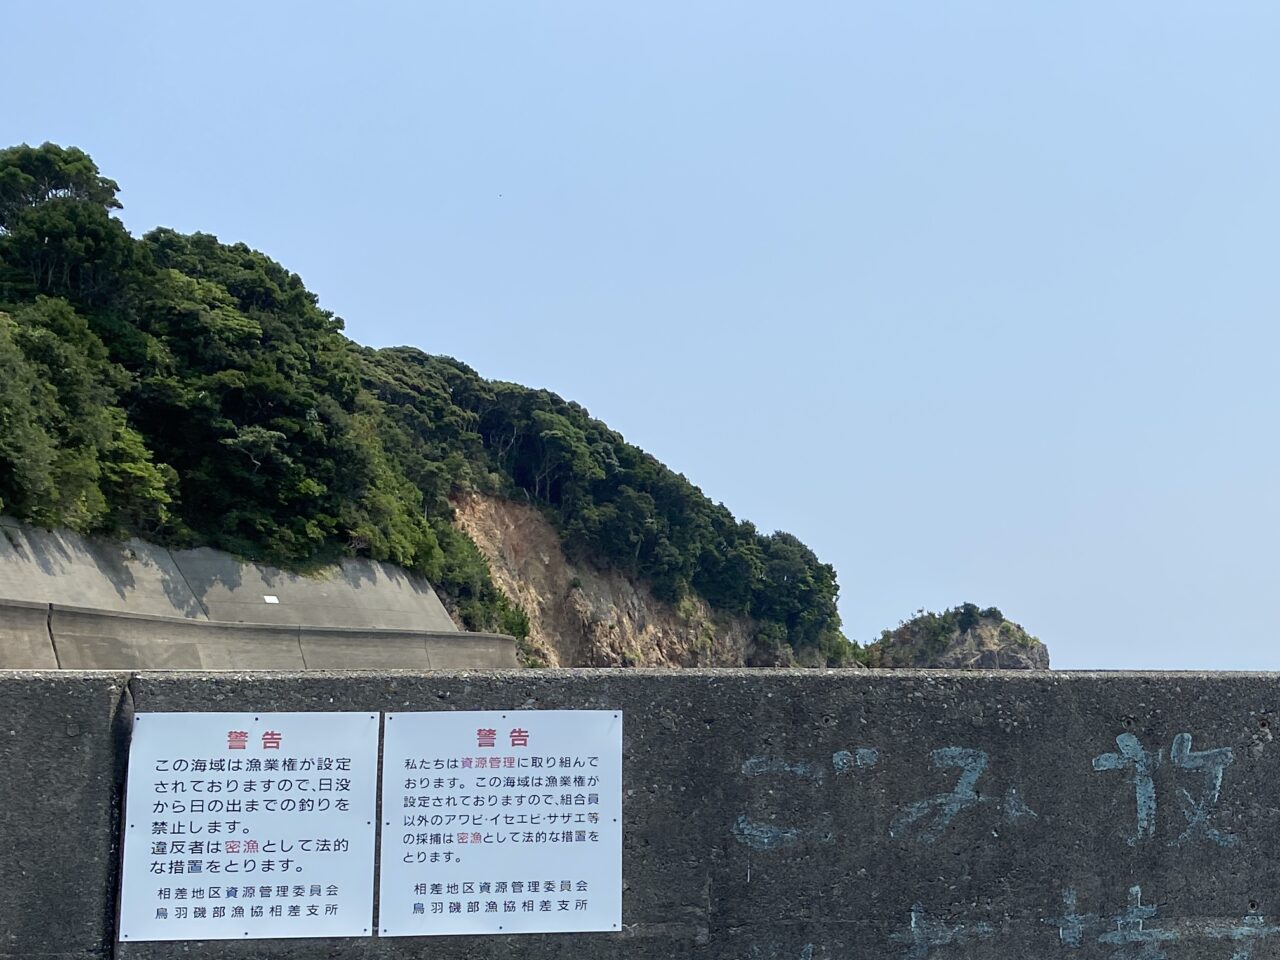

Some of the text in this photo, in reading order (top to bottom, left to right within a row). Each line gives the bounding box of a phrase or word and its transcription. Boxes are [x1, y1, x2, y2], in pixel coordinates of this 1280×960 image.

[228, 731, 282, 749] 警告
[477, 728, 529, 747] 警告
[156, 757, 351, 772] この海域は漁業権が設定
[405, 757, 598, 769] 私たちは資源管理に取り組んで
[154, 778, 351, 793] されておりますので、日没
[405, 776, 599, 789] おります。この海域は漁業権が
[153, 798, 349, 813] から日の出までの釣りを
[404, 793, 599, 807] 設定されておりますので、組合員
[152, 821, 249, 834] 禁止します。
[403, 830, 599, 844] の採捕は密漁として法的な措置を
[151, 838, 348, 855] 違反者は密漁として法的
[403, 851, 460, 863] とります。
[150, 859, 302, 874] な措置をとります。
[158, 885, 338, 899] 相差地区資源管理委員会
[414, 880, 588, 895] 相差地区資源管理委員会
[155, 904, 338, 919] 鳥羽磯部漁協相差支所
[413, 900, 587, 914] 鳥羽磯部漁協相差支所
